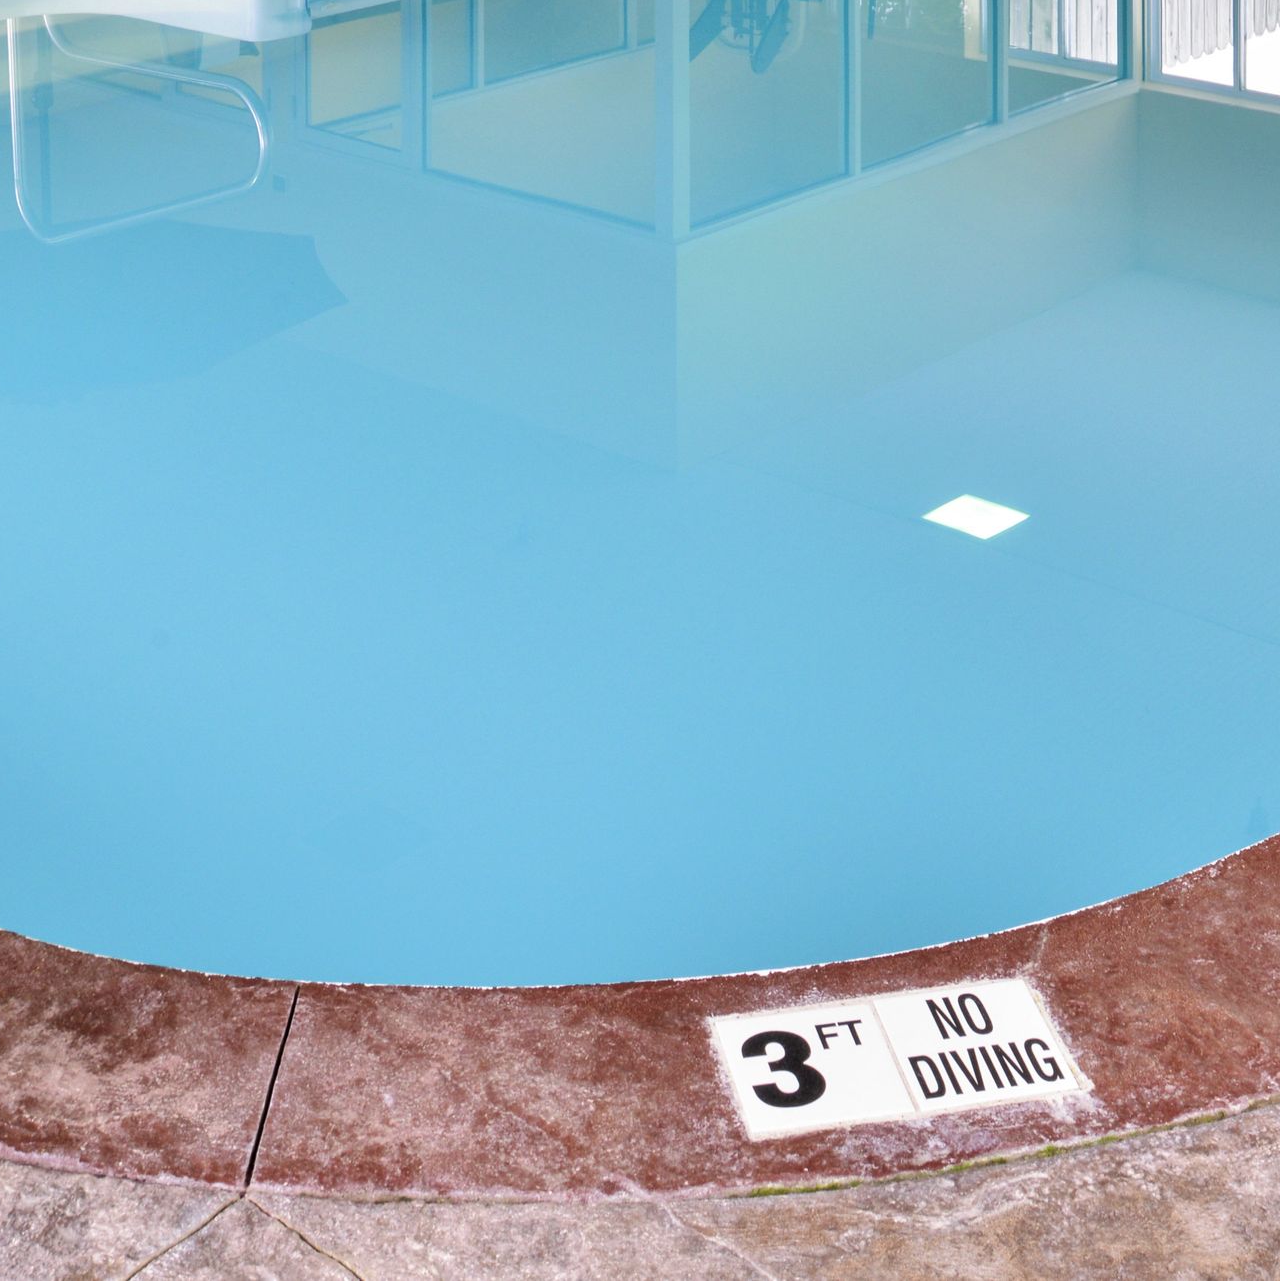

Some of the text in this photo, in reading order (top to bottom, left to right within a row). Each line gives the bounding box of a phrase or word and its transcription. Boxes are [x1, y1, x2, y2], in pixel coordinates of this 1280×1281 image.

[926, 992, 994, 1040] NO
[741, 1019, 863, 1108] 3 FT
[908, 1038, 1065, 1100] DIVING
